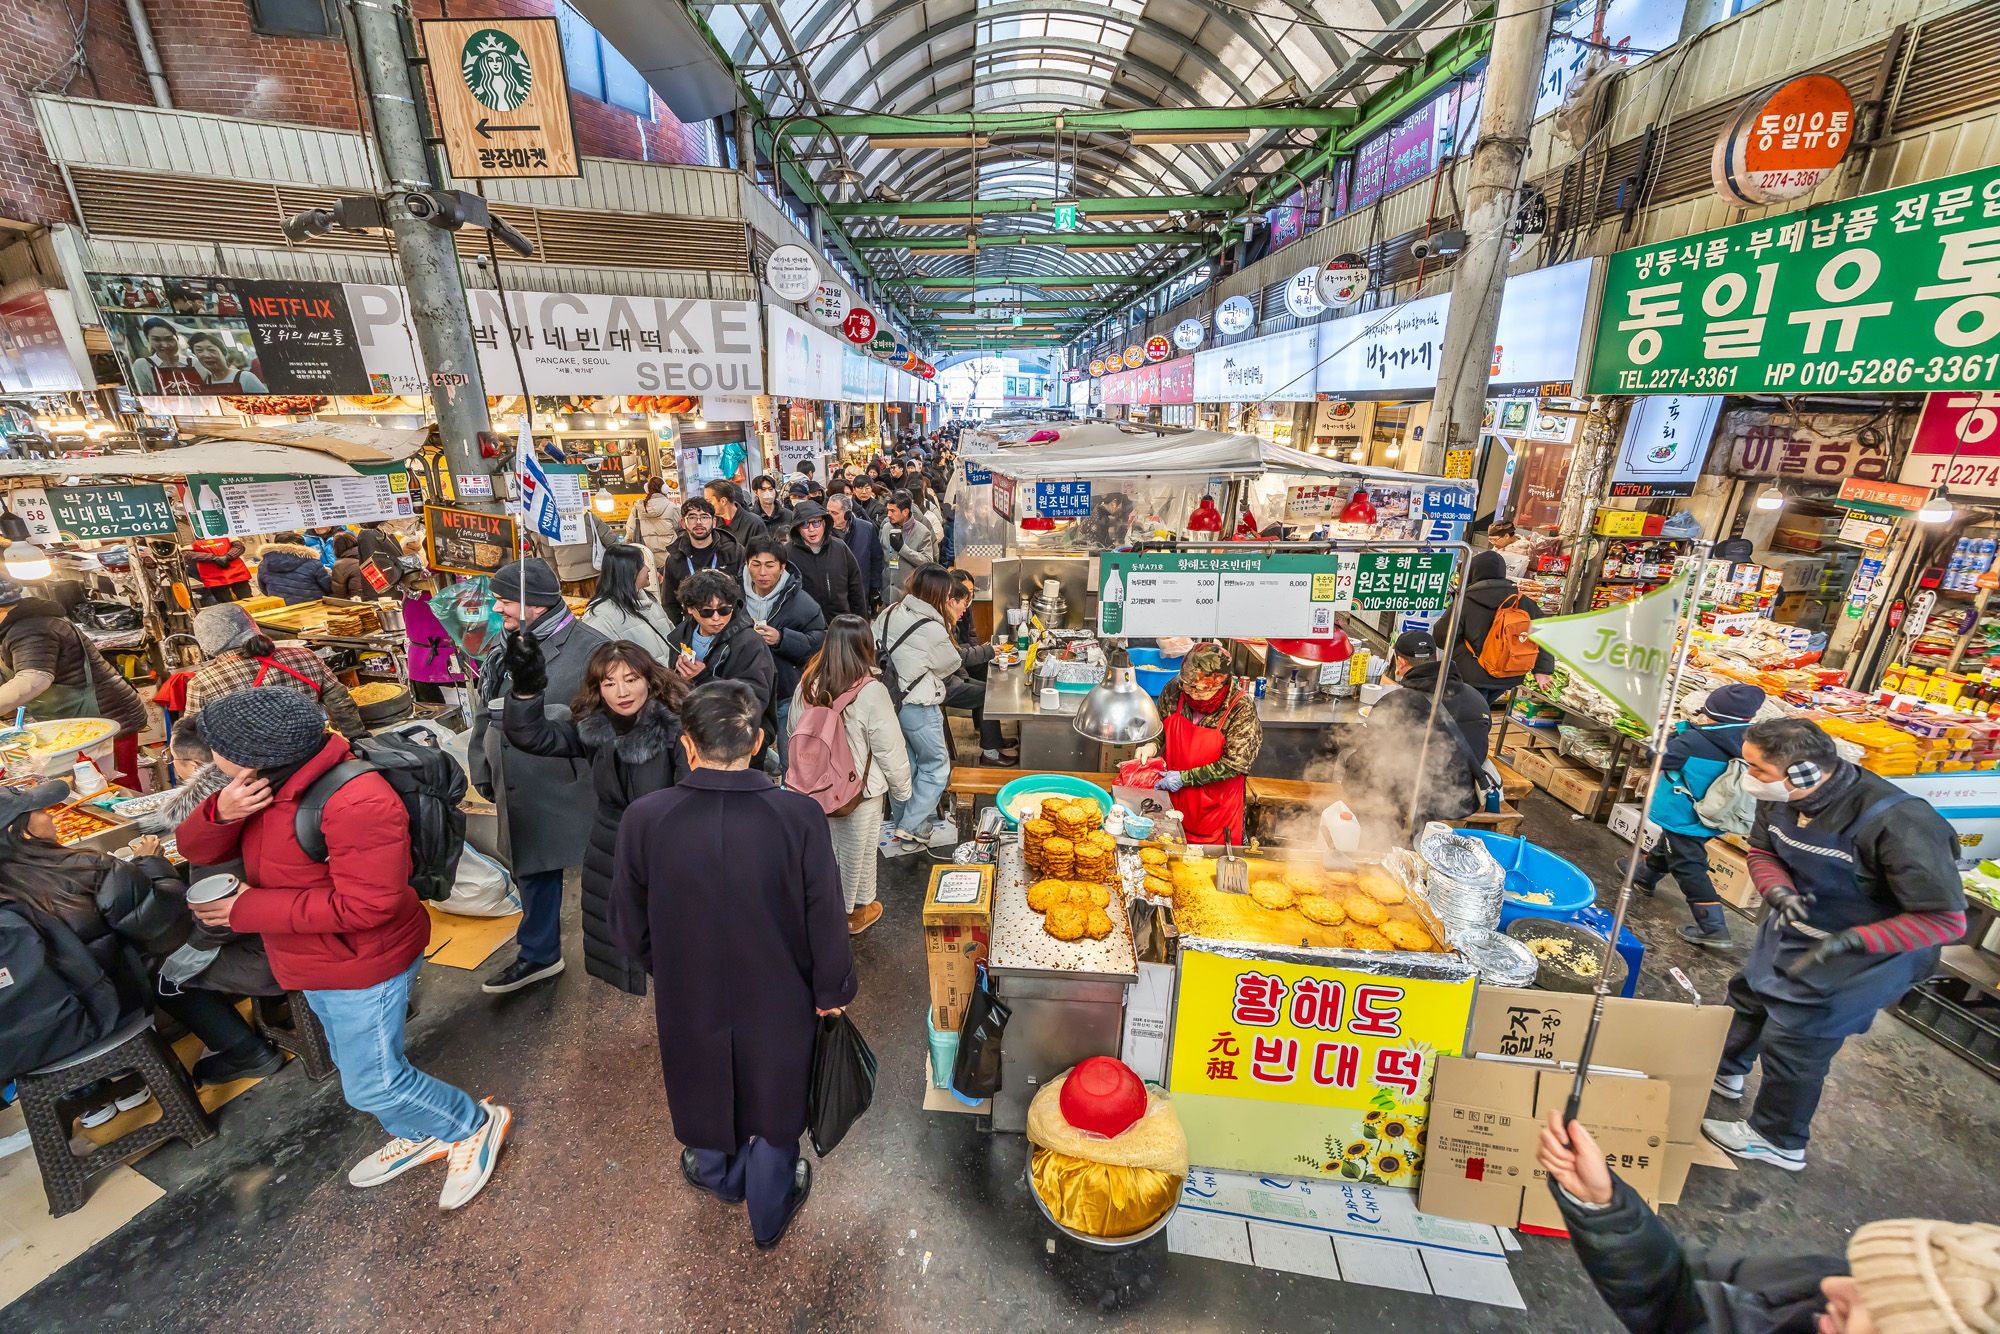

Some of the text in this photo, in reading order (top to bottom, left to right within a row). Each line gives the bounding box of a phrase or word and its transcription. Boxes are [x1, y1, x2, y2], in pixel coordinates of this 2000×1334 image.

[1757, 111, 1849, 151] 동일유통
[478, 147, 548, 169] 광장마켓
[1760, 171, 1820, 189] 2274-3361
[825, 287, 842, 297] 과일
[249, 297, 336, 319] NETFLIX
[824, 298, 842, 309] 쥬스
[345, 284, 752, 354] PNCAKE
[824, 308, 841, 319] 후식
[849, 313, 871, 327] 广场
[259, 328, 273, 345] 길
[277, 329, 302, 341] 위의
[849, 326, 871, 339] 人参
[582, 357, 610, 365] SEOUL
[636, 361, 762, 391] SEOUL
[1764, 362, 1796, 386] HP
[1800, 352, 2000, 386] 010-5286-3361
[1539, 383, 1572, 397] NETFLIX
[1045, 483, 1087, 495] 황해도
[1613, 485, 1652, 496] NETFLIX
[1843, 486, 1898, 504] 쓰레기봉투
[16, 498, 48, 508] 동부A
[63, 490, 124, 505] 박가네
[1038, 495, 1090, 509] 원조빈대떡
[1411, 496, 1422, 506] 46
[1428, 491, 1471, 508] 현이네
[26, 509, 46, 522] 58
[1849, 511, 1870, 521] CCTV
[33, 524, 51, 535] 호
[79, 520, 169, 537] 2267-0614
[442, 510, 502, 536] NETFLIX
[1177, 558, 1262, 571] 황해도원조빈대떡
[1374, 556, 1432, 570] 황해도
[1197, 579, 1215, 587] 5,000
[1337, 575, 1352, 587] 73
[1357, 571, 1445, 594] 원조빈대떡
[1363, 597, 1439, 610] 010-9166-0661
[1234, 972, 1404, 1037] 황해도
[1252, 1035, 1424, 1098] 빈대떡
[1300, 1185, 1312, 1196] kg
